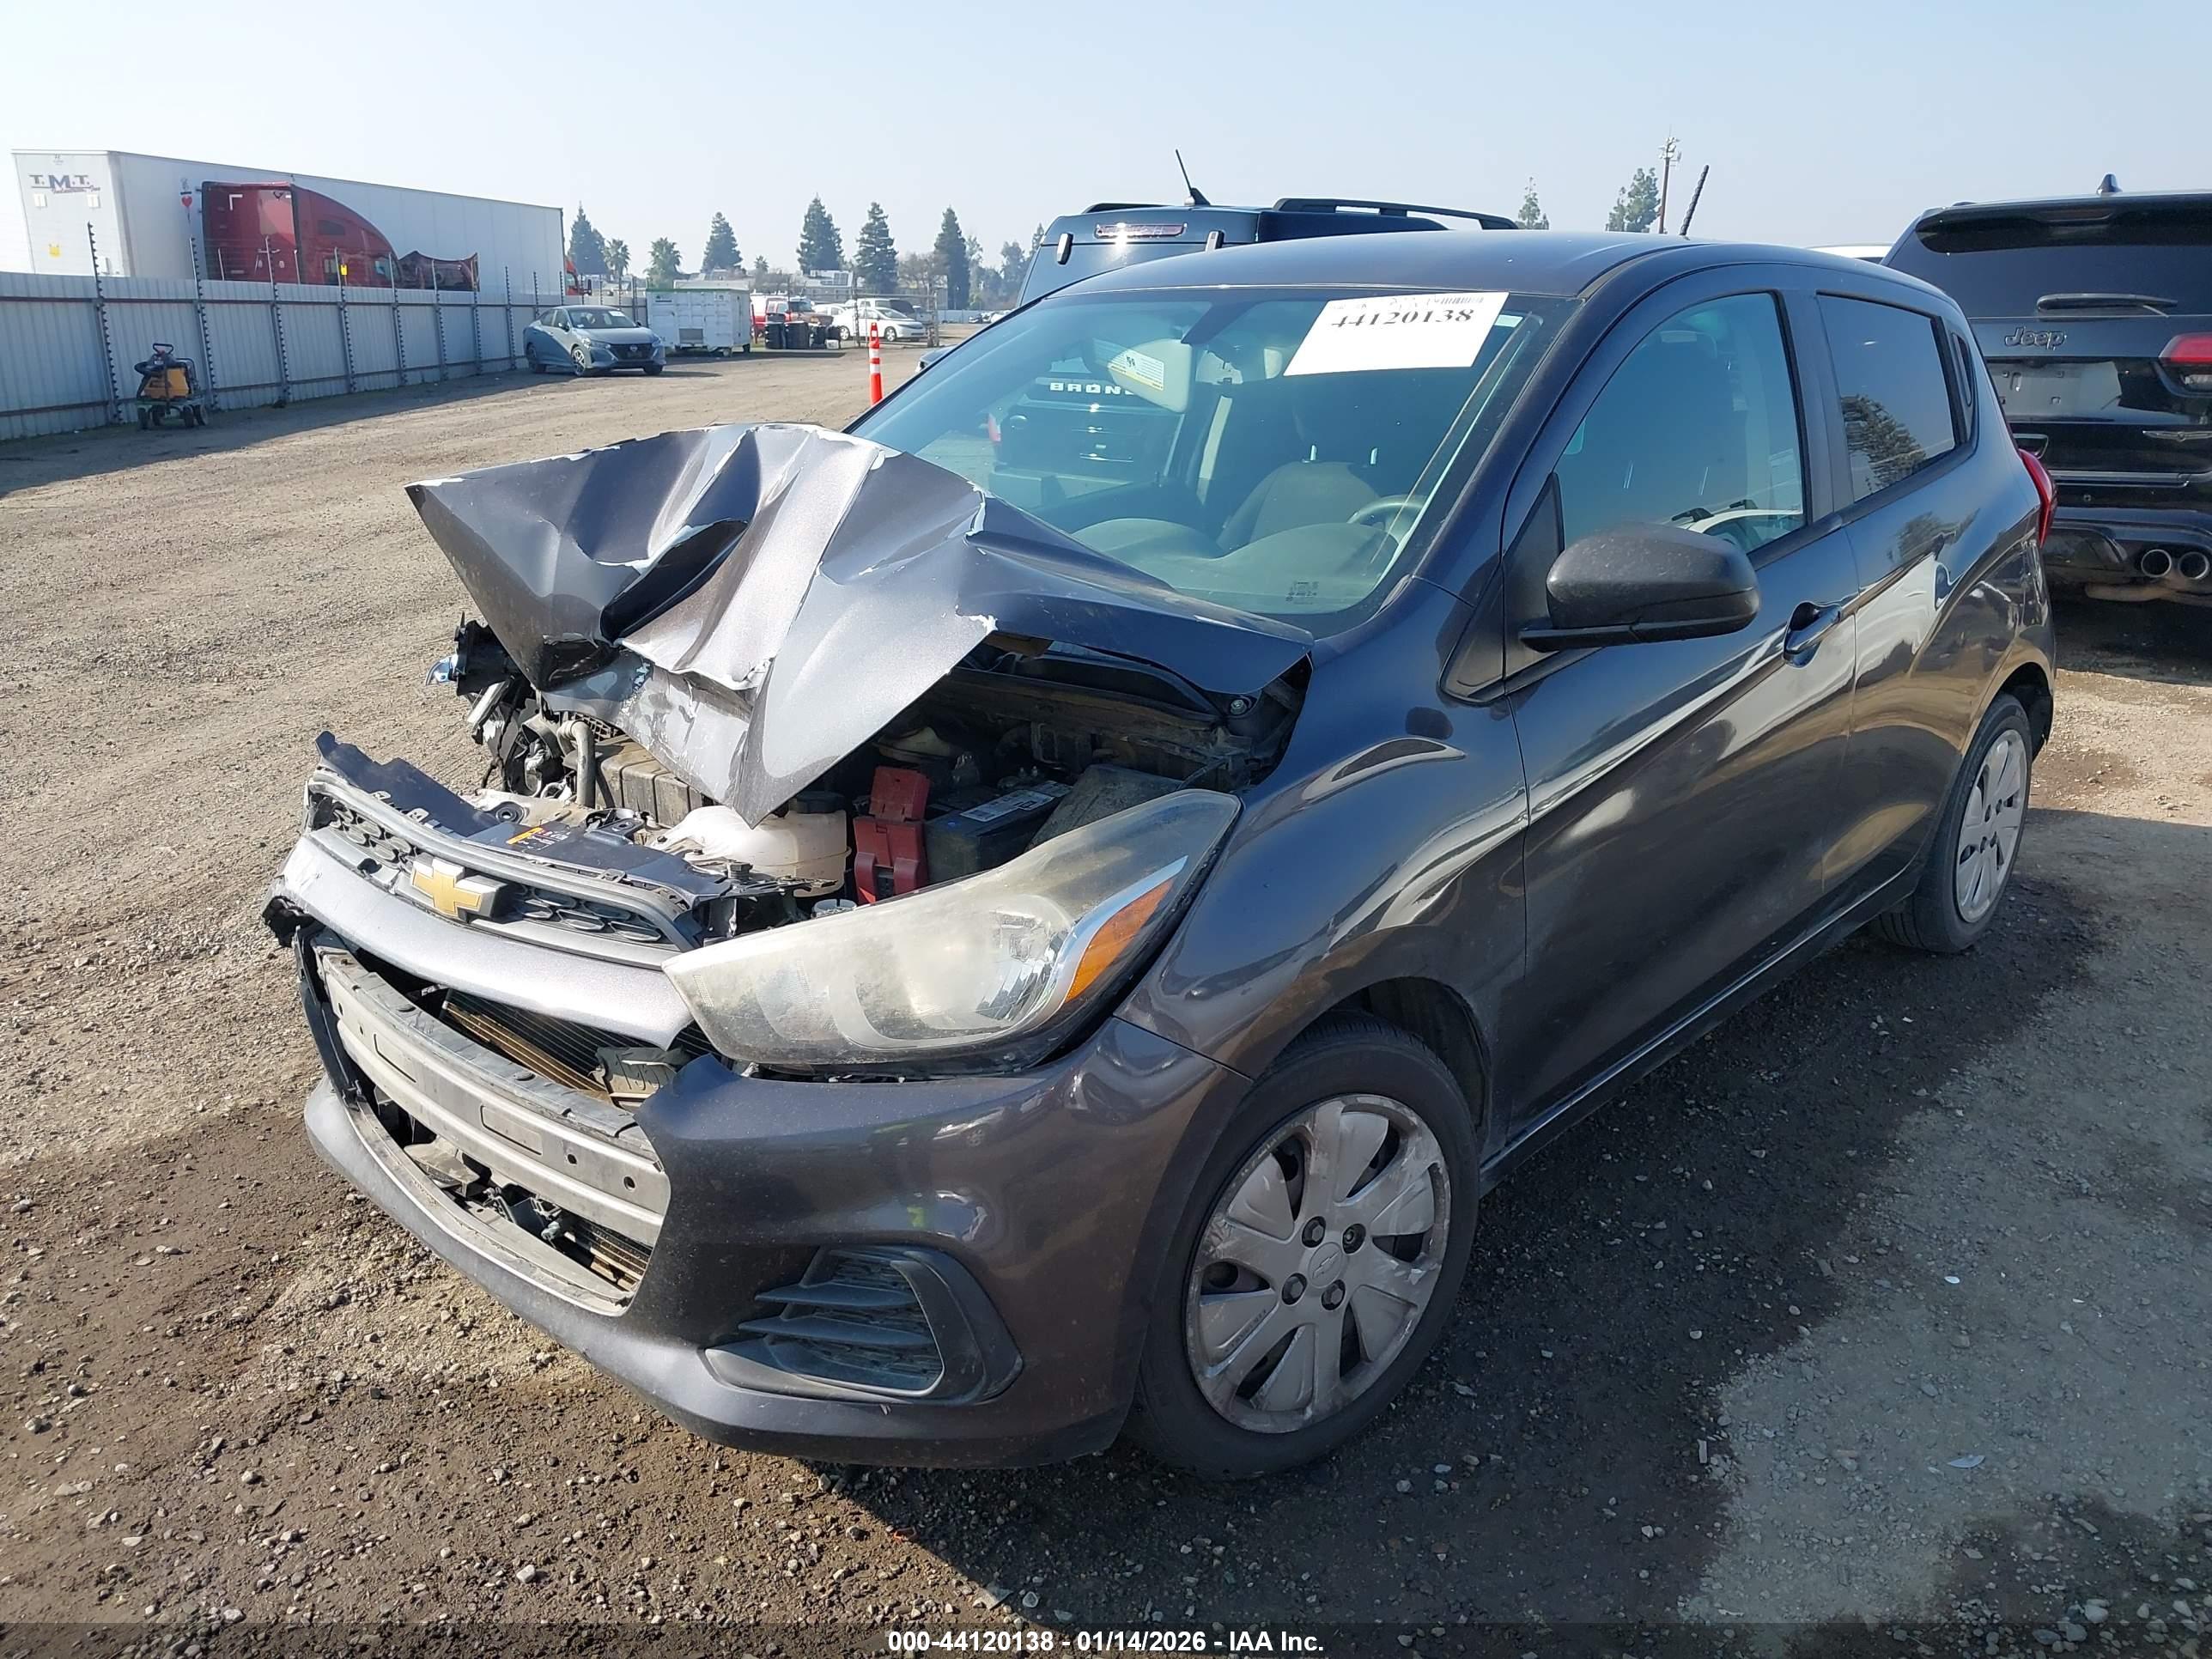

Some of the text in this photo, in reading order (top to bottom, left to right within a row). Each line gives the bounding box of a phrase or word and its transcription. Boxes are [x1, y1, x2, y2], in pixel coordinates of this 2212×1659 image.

[1331, 307, 1475, 328] 44120138
[2005, 326, 2065, 350] Jeep
[1049, 382, 1134, 395] BRON
